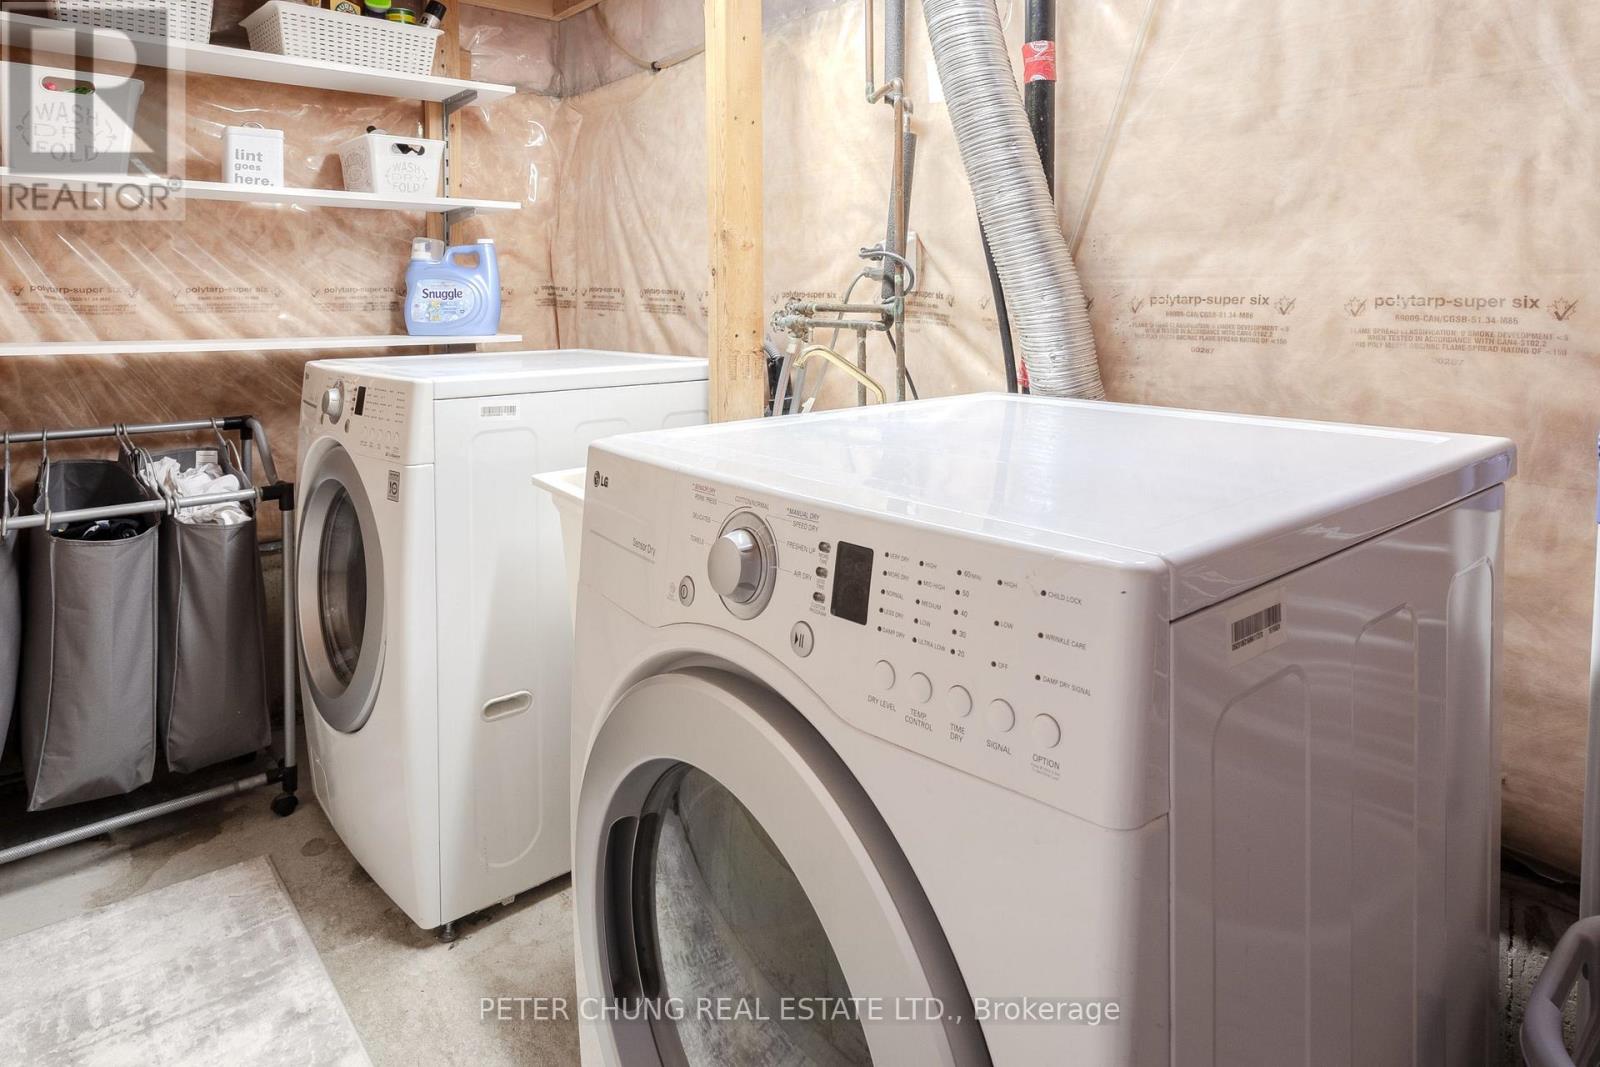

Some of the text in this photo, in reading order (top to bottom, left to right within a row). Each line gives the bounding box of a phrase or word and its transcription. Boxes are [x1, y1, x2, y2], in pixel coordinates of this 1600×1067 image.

[35, 102, 98, 126] WASH
[36, 141, 99, 163] FOLD
[235, 148, 264, 162] lint
[234, 163, 261, 171] goes
[391, 161, 421, 175] WASH
[234, 173, 274, 187] here.
[391, 182, 421, 193] FOLD
[422, 288, 463, 300] Snuggle
[1150, 294, 1270, 307] polytarp-super six
[1374, 294, 1540, 310] polytarp-super six
[600, 475, 609, 488] LG
[792, 519, 807, 531] SPEED
[786, 540, 808, 553] FRESHEN
[925, 562, 937, 570] HIGH
[1004, 581, 1018, 590] HIGH
[885, 589, 904, 600] NORMAL
[962, 590, 970, 598] 50
[1048, 591, 1082, 606] CHILD LOCK
[921, 600, 942, 611] MEDIUM
[960, 610, 968, 618] 40
[919, 618, 931, 628] LOW
[1000, 621, 1014, 630] LOW
[959, 630, 967, 639] 30
[918, 637, 946, 652] ULTRA LOW
[1045, 633, 1087, 651] WRINKLE CARE
[957, 649, 965, 658] 20
[998, 662, 1008, 670] OFF
[1042, 675, 1092, 697] DAMP DRY SIGNAL
[867, 694, 897, 713] DRY LEVEL
[909, 707, 927, 720] TEMP
[904, 715, 934, 733] CONTROL
[949, 723, 966, 736] TIME
[949, 732, 964, 743] DRY
[986, 739, 1012, 756] SIGNAL
[1032, 753, 1061, 771] OPTION
